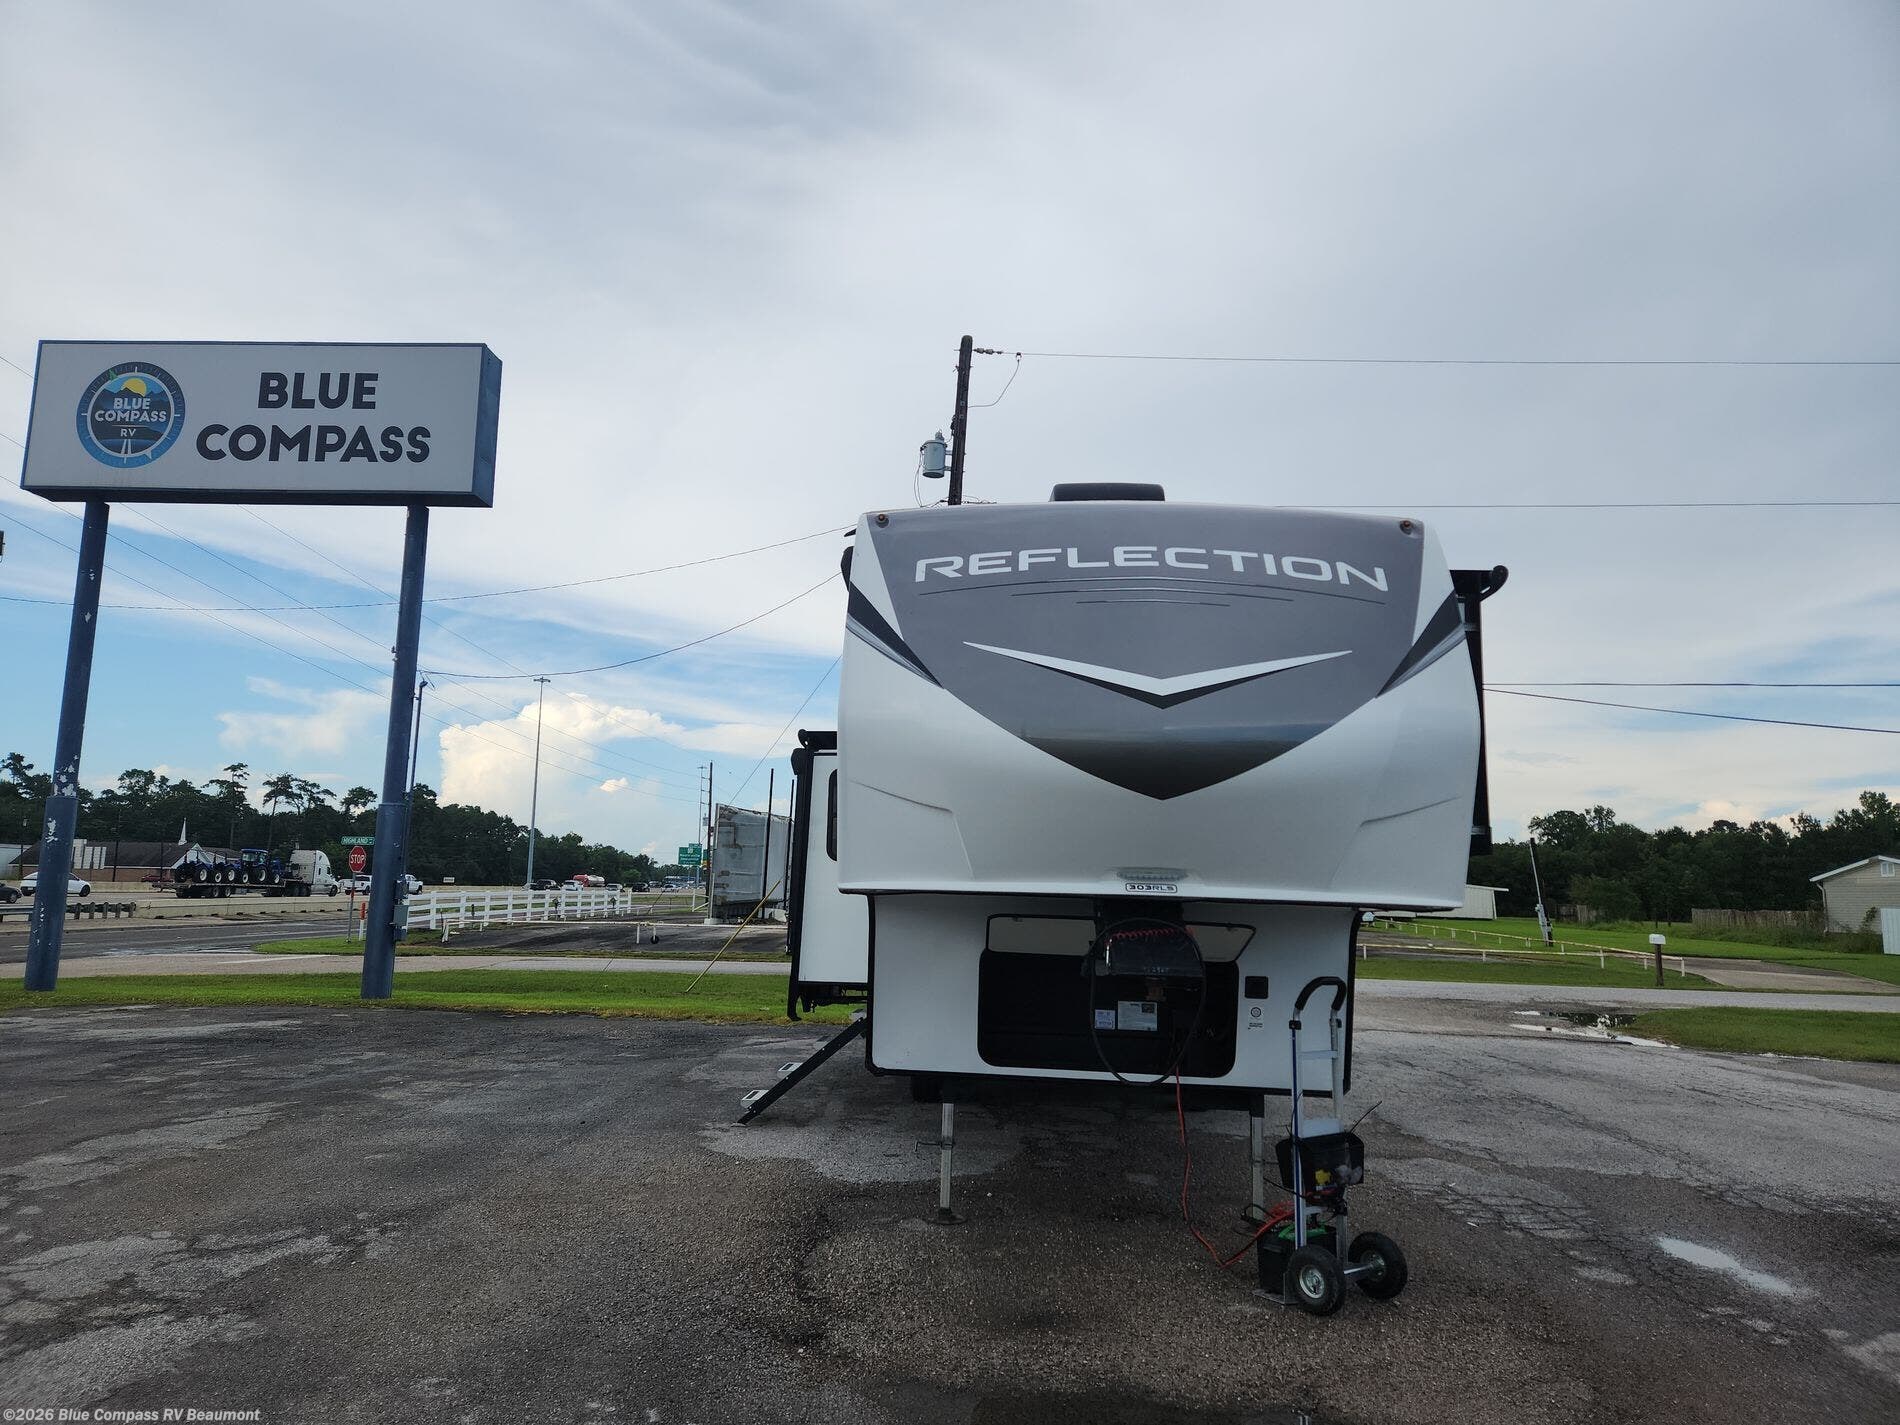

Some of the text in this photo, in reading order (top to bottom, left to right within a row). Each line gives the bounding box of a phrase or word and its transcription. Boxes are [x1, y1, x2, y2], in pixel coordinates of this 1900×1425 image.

[258, 372, 379, 410] BLUE
[113, 397, 151, 410] BLUE
[94, 410, 167, 423] COMPASS
[120, 428, 137, 437] RV
[196, 423, 431, 463] COMPASS
[914, 546, 1389, 592] REFLECTION
[350, 854, 365, 864] STOP
